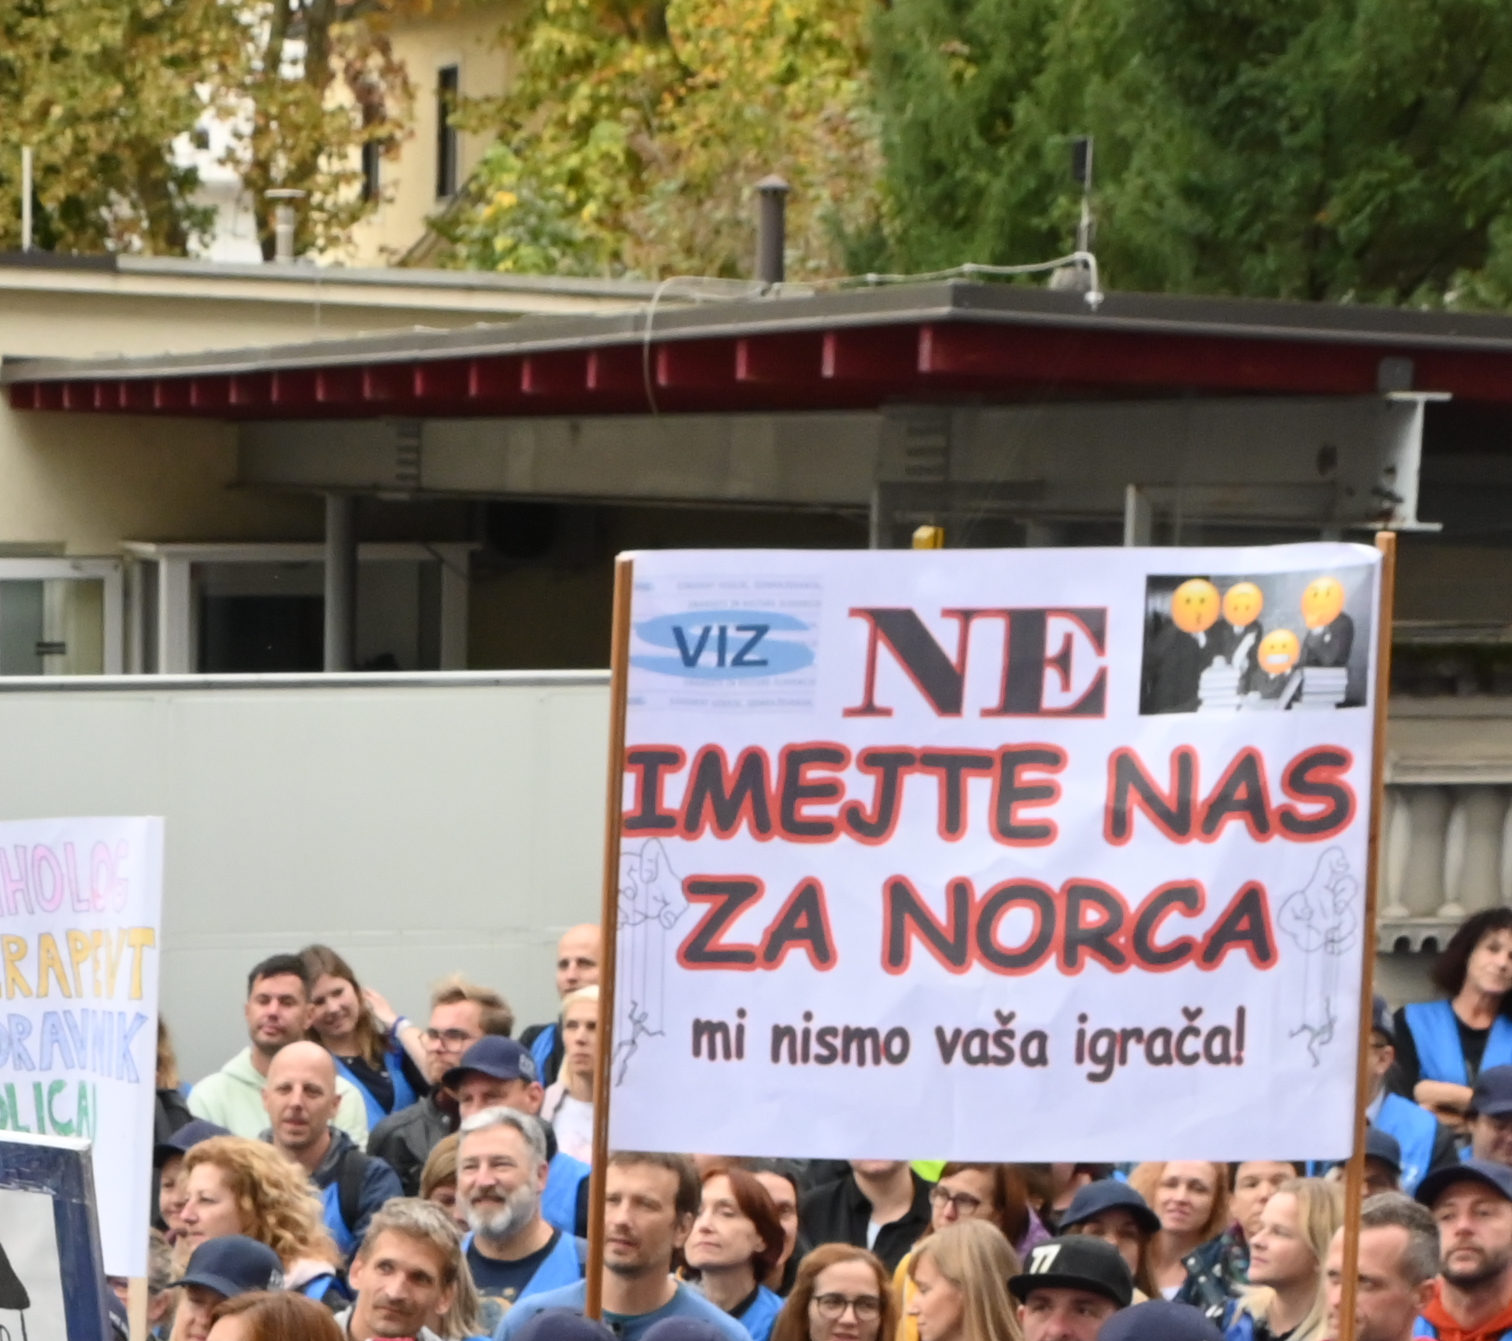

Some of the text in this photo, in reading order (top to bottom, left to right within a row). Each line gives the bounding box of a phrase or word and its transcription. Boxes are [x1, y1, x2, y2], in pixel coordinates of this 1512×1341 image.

[672, 604, 1109, 718] VIZ NE
[622, 740, 1358, 847] IMEJTE NAS
[676, 873, 1279, 976] ZA NORCA
[691, 1004, 1247, 1083] mi nismo vaša igrača!
